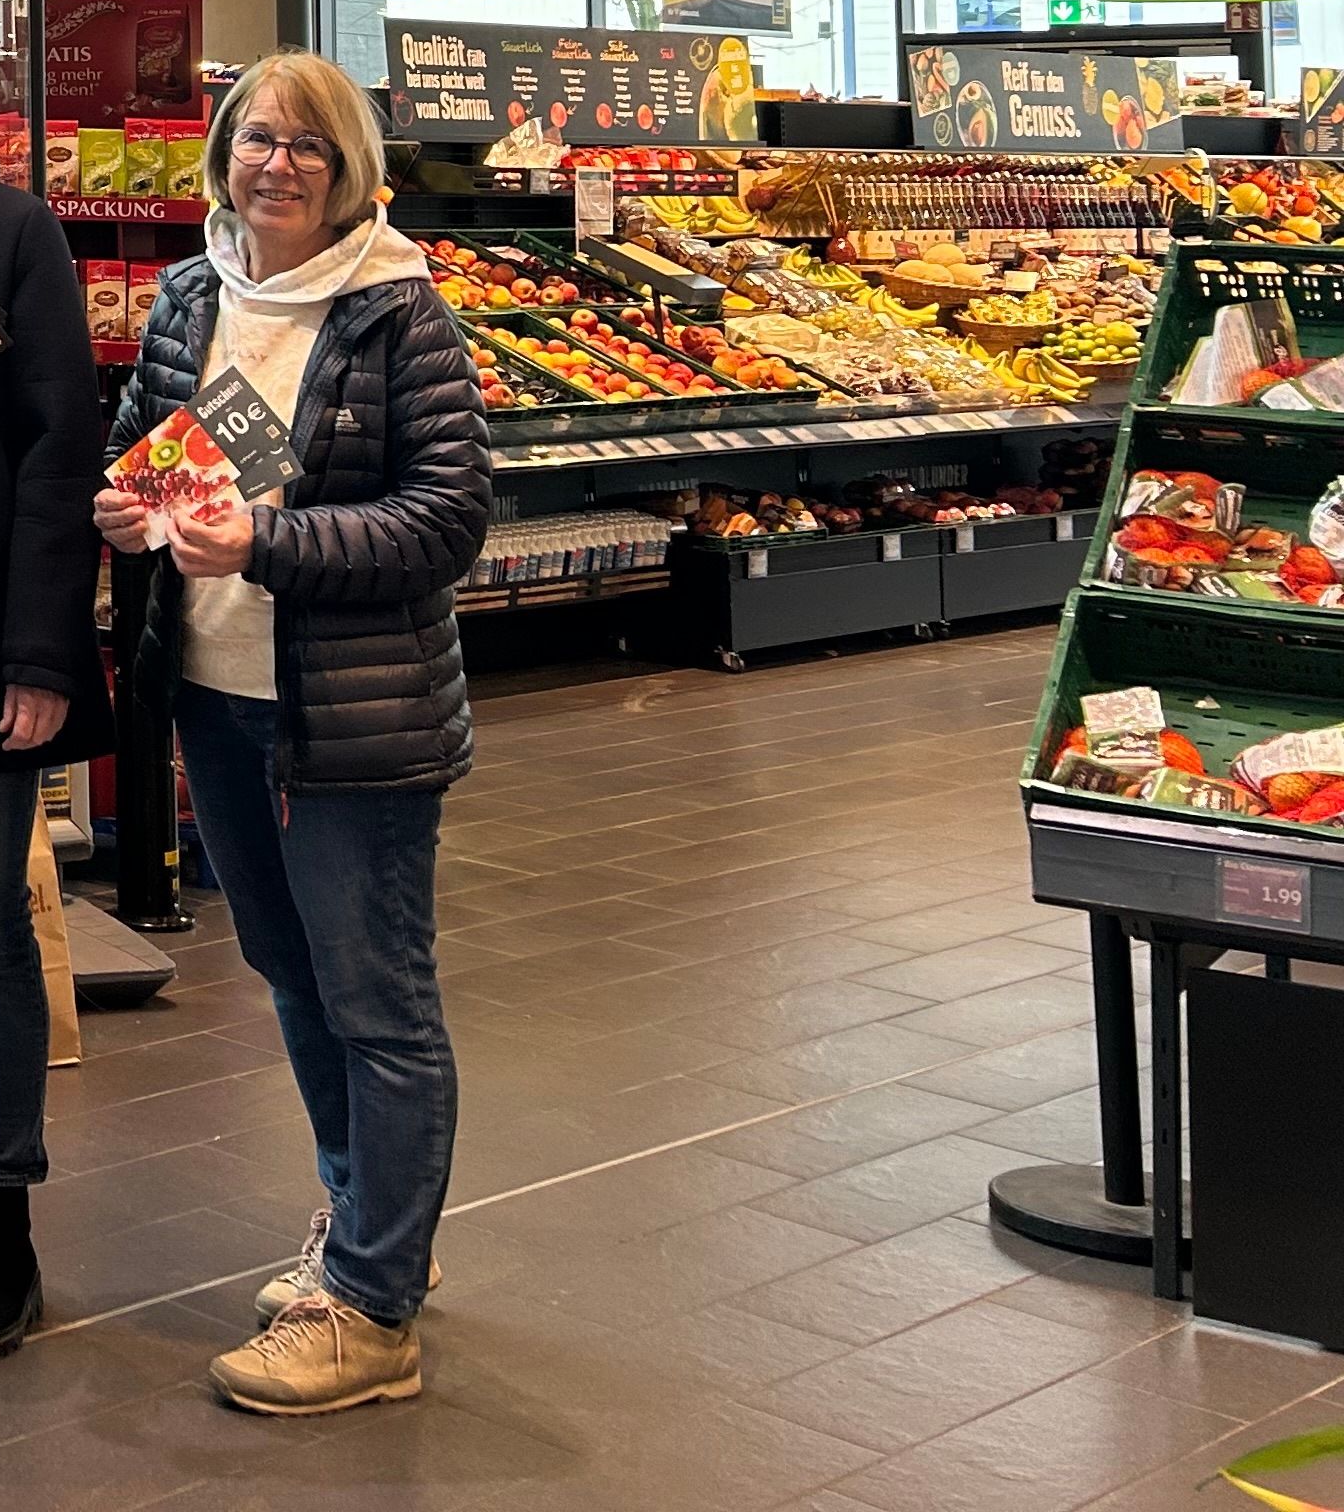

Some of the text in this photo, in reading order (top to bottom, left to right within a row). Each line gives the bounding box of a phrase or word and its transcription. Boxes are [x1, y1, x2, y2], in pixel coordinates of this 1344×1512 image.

[46, 46, 93, 63] ATIS
[401, 32, 467, 70] Qualität
[62, 67, 104, 81] mehr
[405, 69, 422, 88] bei
[440, 70, 465, 90] nicht
[1001, 59, 1029, 92] Reif
[414, 90, 495, 121] vom Stamm.
[1008, 94, 1082, 138] Genuss.
[1261, 886, 1302, 907] 1.99
